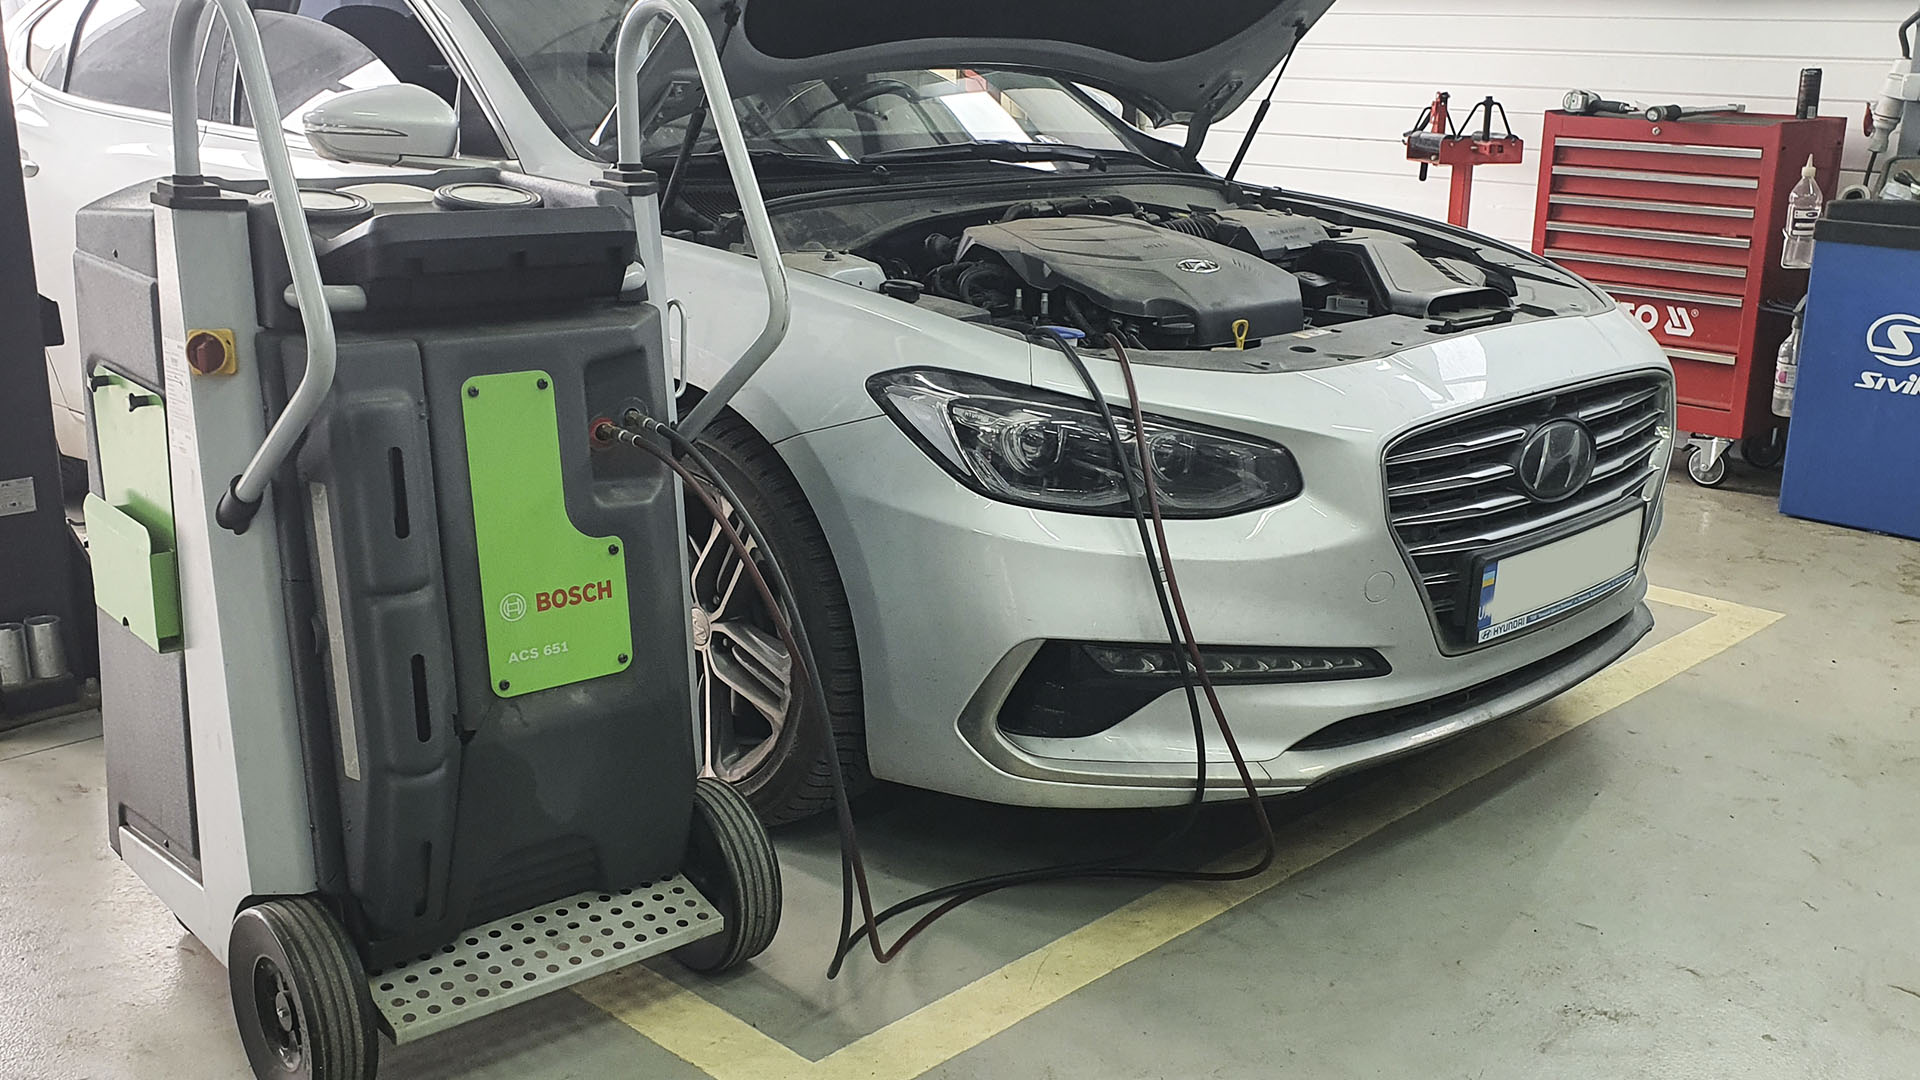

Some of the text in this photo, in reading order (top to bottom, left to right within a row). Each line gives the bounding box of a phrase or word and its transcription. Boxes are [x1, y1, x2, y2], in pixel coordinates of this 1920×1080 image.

[536, 580, 612, 612] BOSCH
[1493, 617, 1525, 636] HYUNDAI
[508, 641, 569, 664] ACS 651
